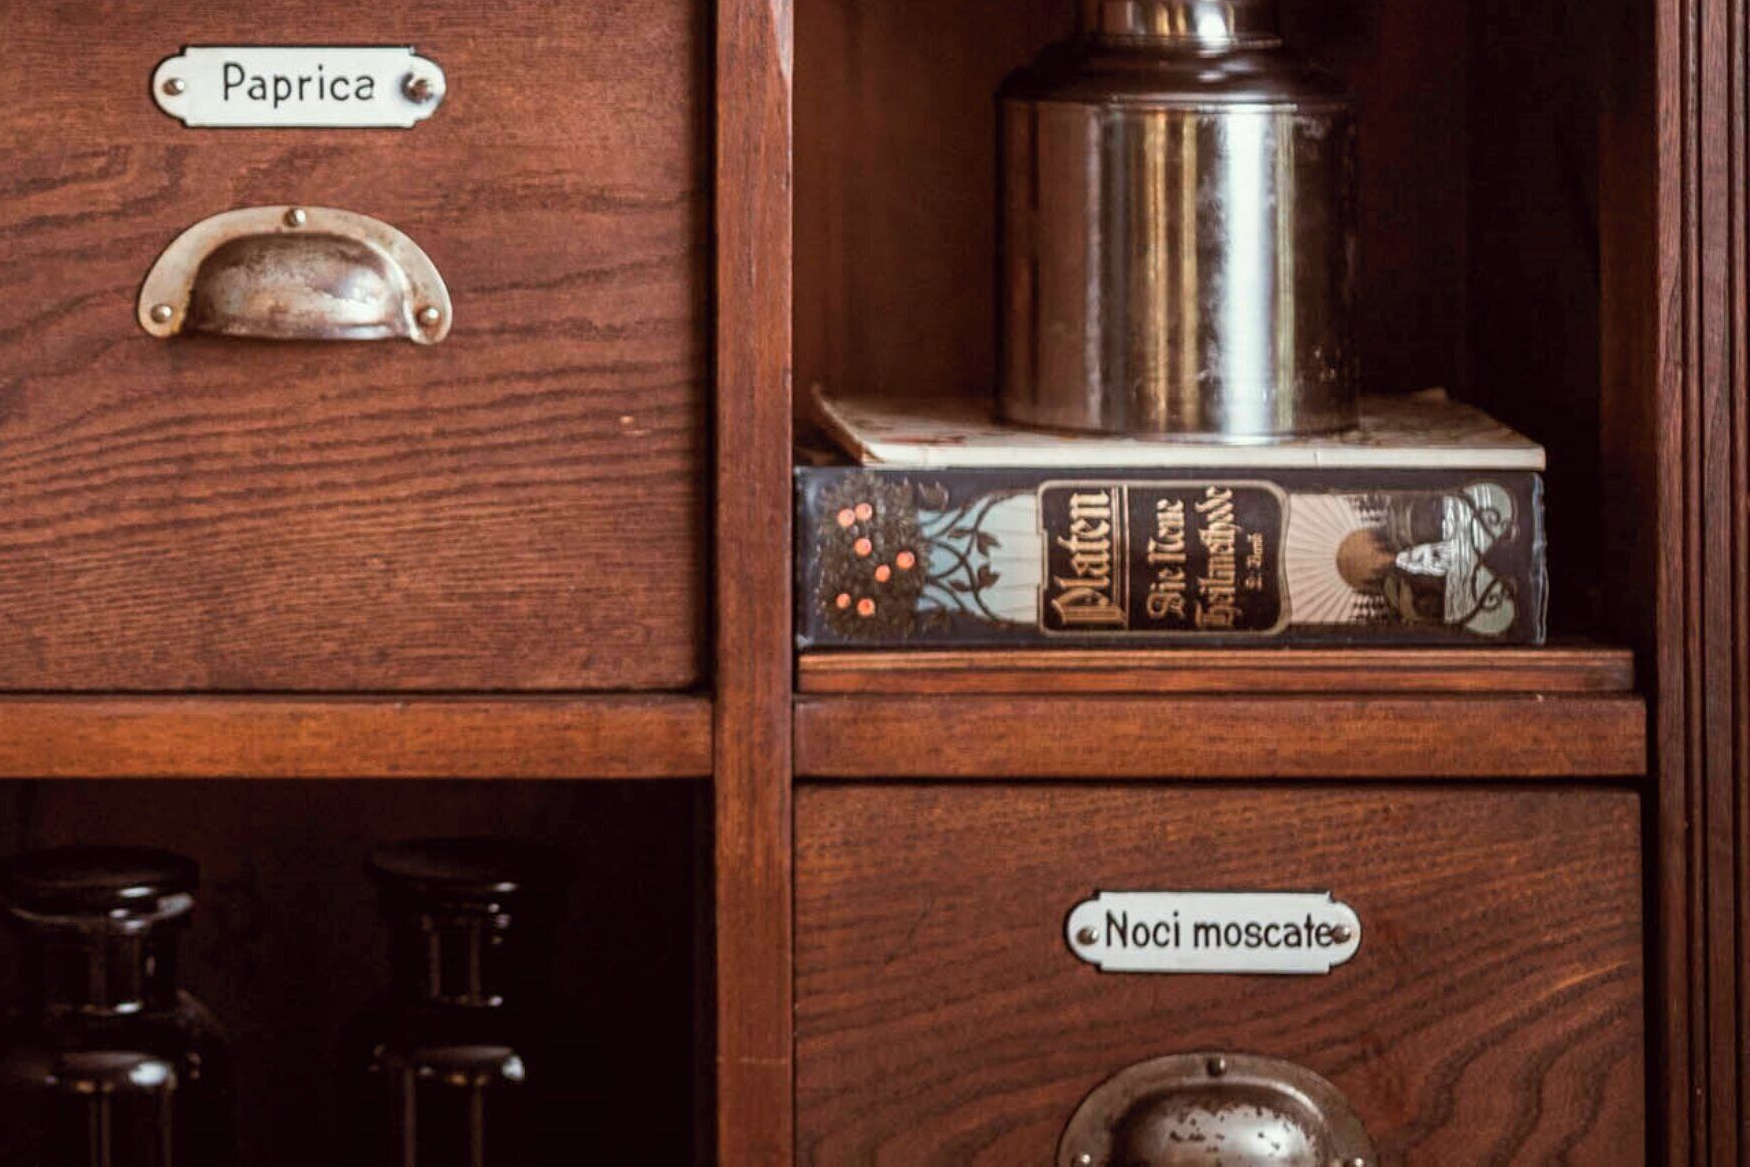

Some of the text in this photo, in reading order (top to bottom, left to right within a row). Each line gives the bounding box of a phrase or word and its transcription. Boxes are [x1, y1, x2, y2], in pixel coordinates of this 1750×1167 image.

[223, 62, 374, 109] Paprica
[1051, 491, 1127, 626] Platen
[1105, 909, 1332, 948] Noci moscate
